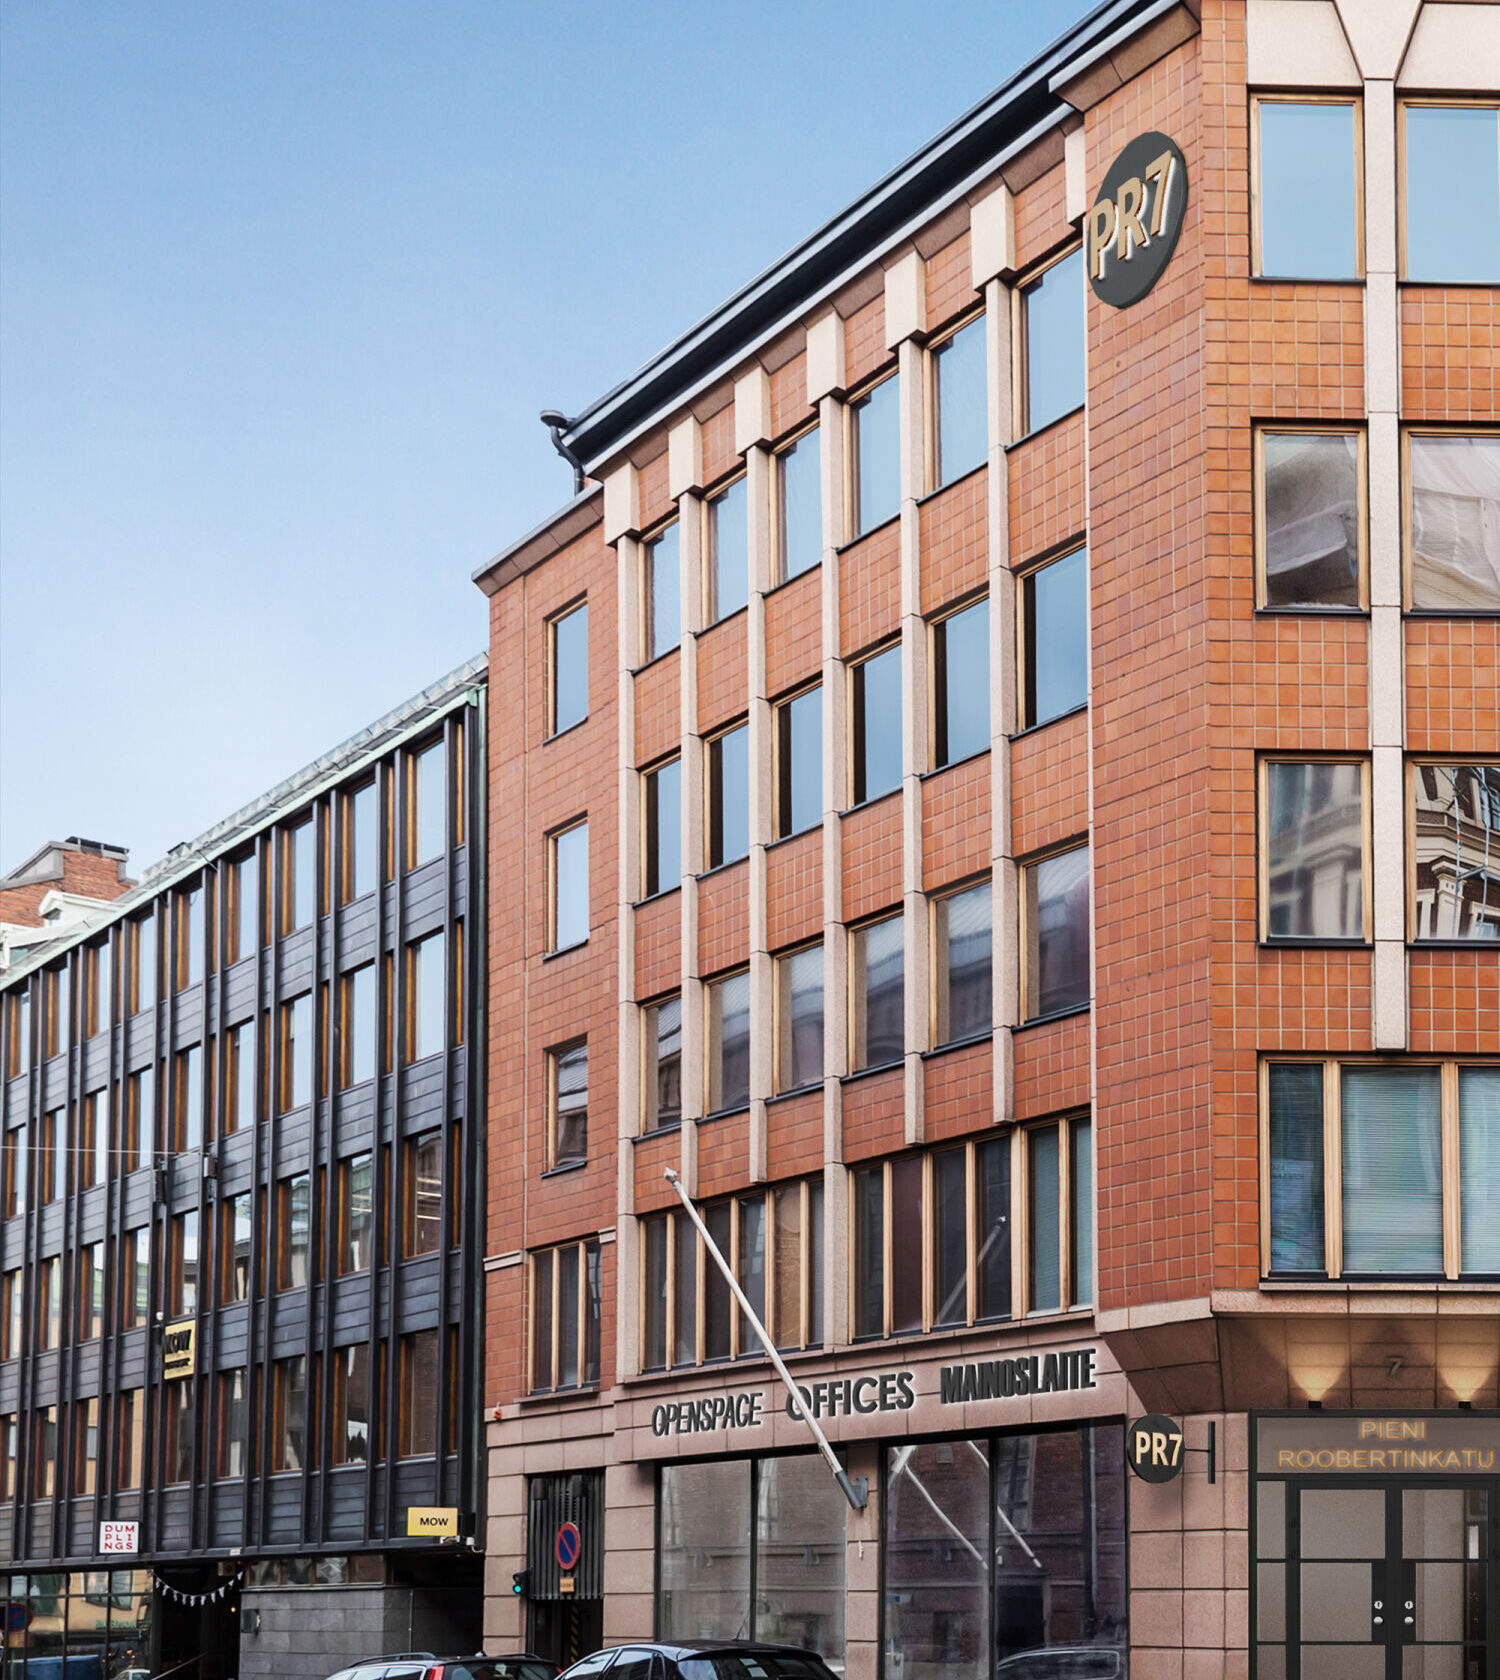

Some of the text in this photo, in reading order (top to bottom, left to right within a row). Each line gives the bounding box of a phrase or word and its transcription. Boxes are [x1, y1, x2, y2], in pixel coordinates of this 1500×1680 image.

[1090, 150, 1175, 280] PR7
[652, 1349, 1096, 1436] OPENSPACE OFFICES MAINOSLAITE
[1360, 1421, 1426, 1440] PIENI
[1135, 1431, 1183, 1467] PR7
[1277, 1449, 1494, 1468] ROOBERTINKATU
[105, 1524, 135, 1533] DUM
[420, 1517, 449, 1526] MOW
